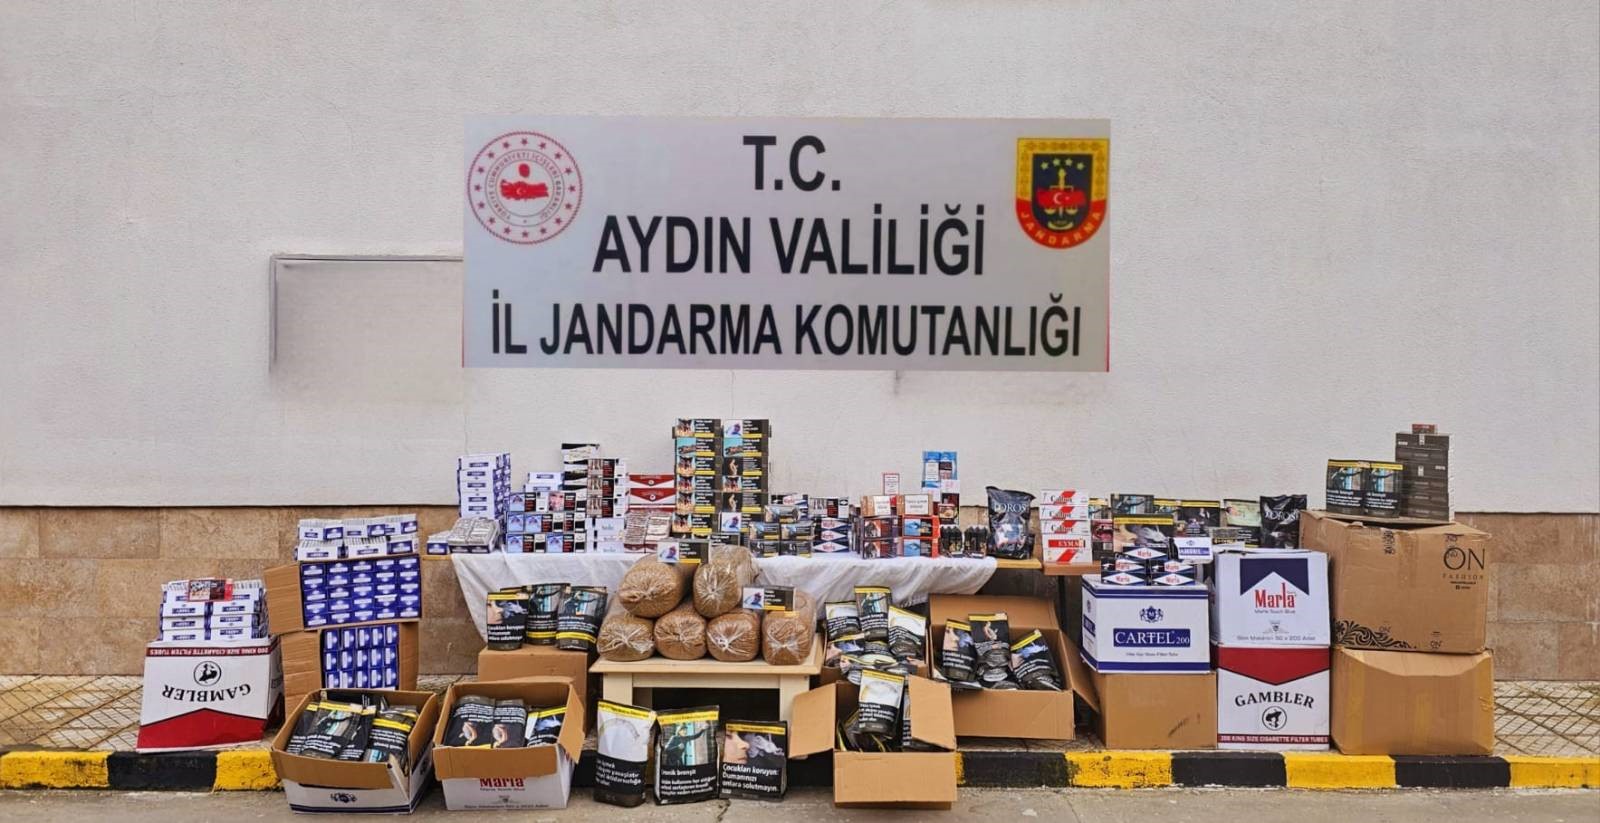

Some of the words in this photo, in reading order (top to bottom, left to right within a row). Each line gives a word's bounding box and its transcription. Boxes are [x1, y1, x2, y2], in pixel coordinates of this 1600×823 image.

[743, 135, 842, 192] T.C.
[1020, 211, 1101, 246] JANDARMA
[592, 214, 750, 275] AYDIN
[768, 203, 985, 276] VALİLİĞİ
[491, 289, 528, 356] İL
[539, 303, 784, 356] JANDARMA
[795, 293, 1082, 357] KOMUTANLIĞI
[1443, 547, 1486, 571] ON
[1254, 582, 1295, 609] Marla
[1115, 631, 1175, 645] CARTEL
[1176, 636, 1190, 645] 200
[149, 648, 170, 656] TUBES
[171, 648, 191, 656] FILTER
[192, 648, 226, 656] CIGARETTE
[162, 683, 251, 702] GAMBLER
[1234, 691, 1315, 709] GAMBLER
